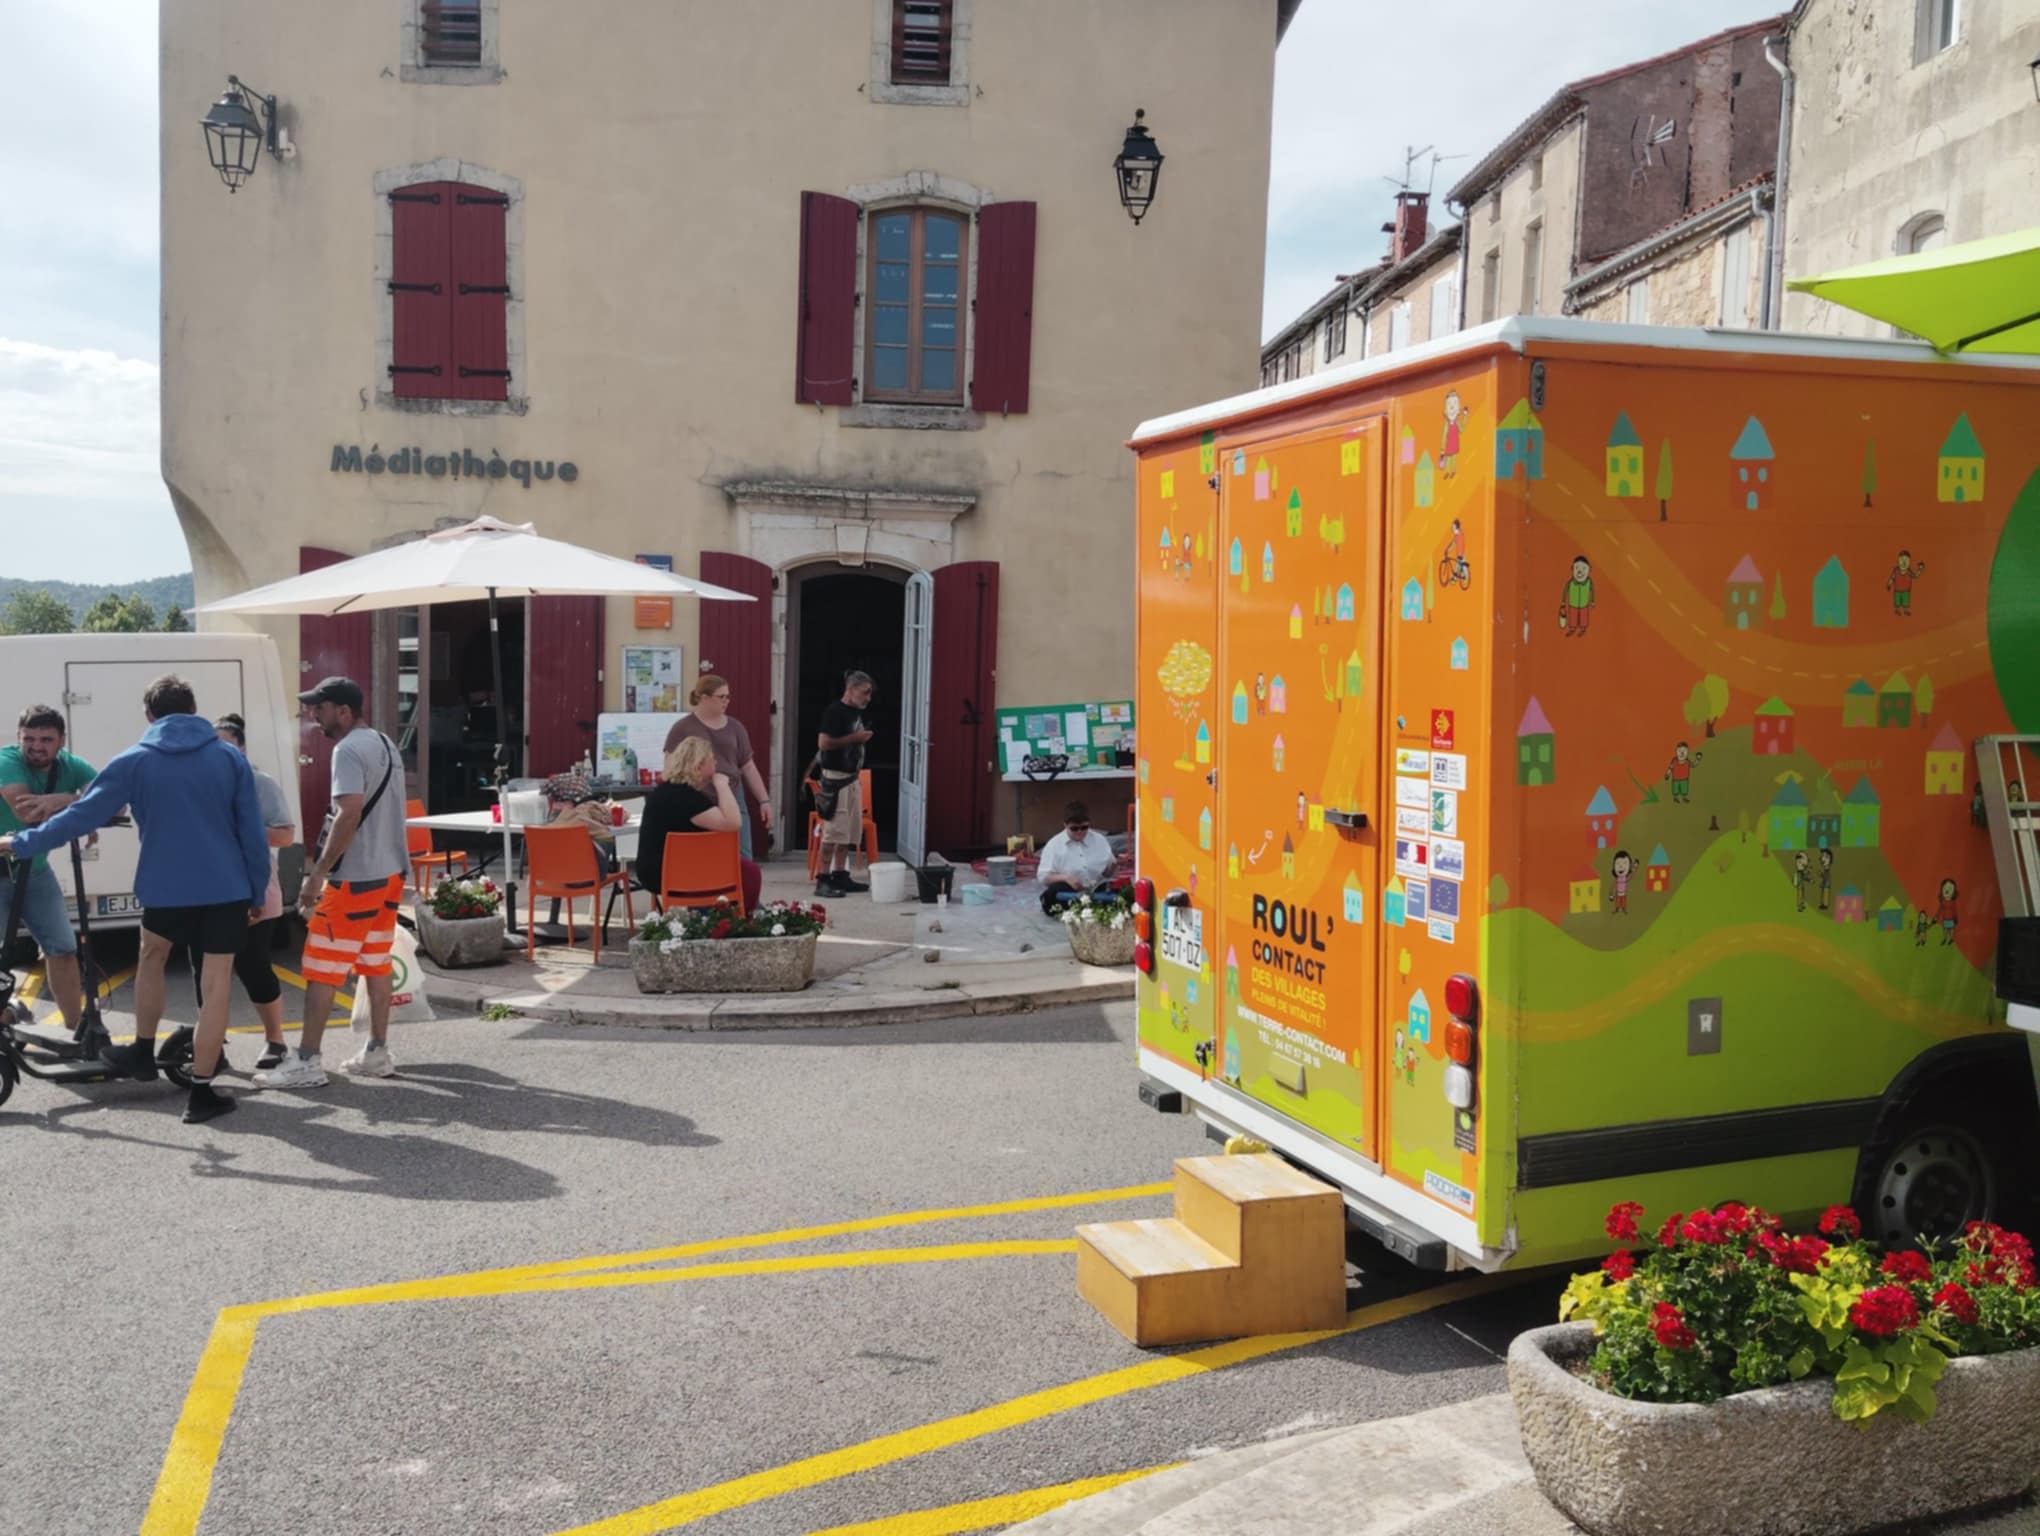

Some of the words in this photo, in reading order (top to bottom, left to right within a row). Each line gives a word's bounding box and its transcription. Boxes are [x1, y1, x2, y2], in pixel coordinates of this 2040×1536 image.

[330, 443, 579, 489] Médiathèque
[1163, 931, 1200, 967] 507-DZ
[1252, 939, 1326, 985] CONTACT
[1251, 966, 1272, 989] DES
[1274, 974, 1326, 1011] VILLAGES
